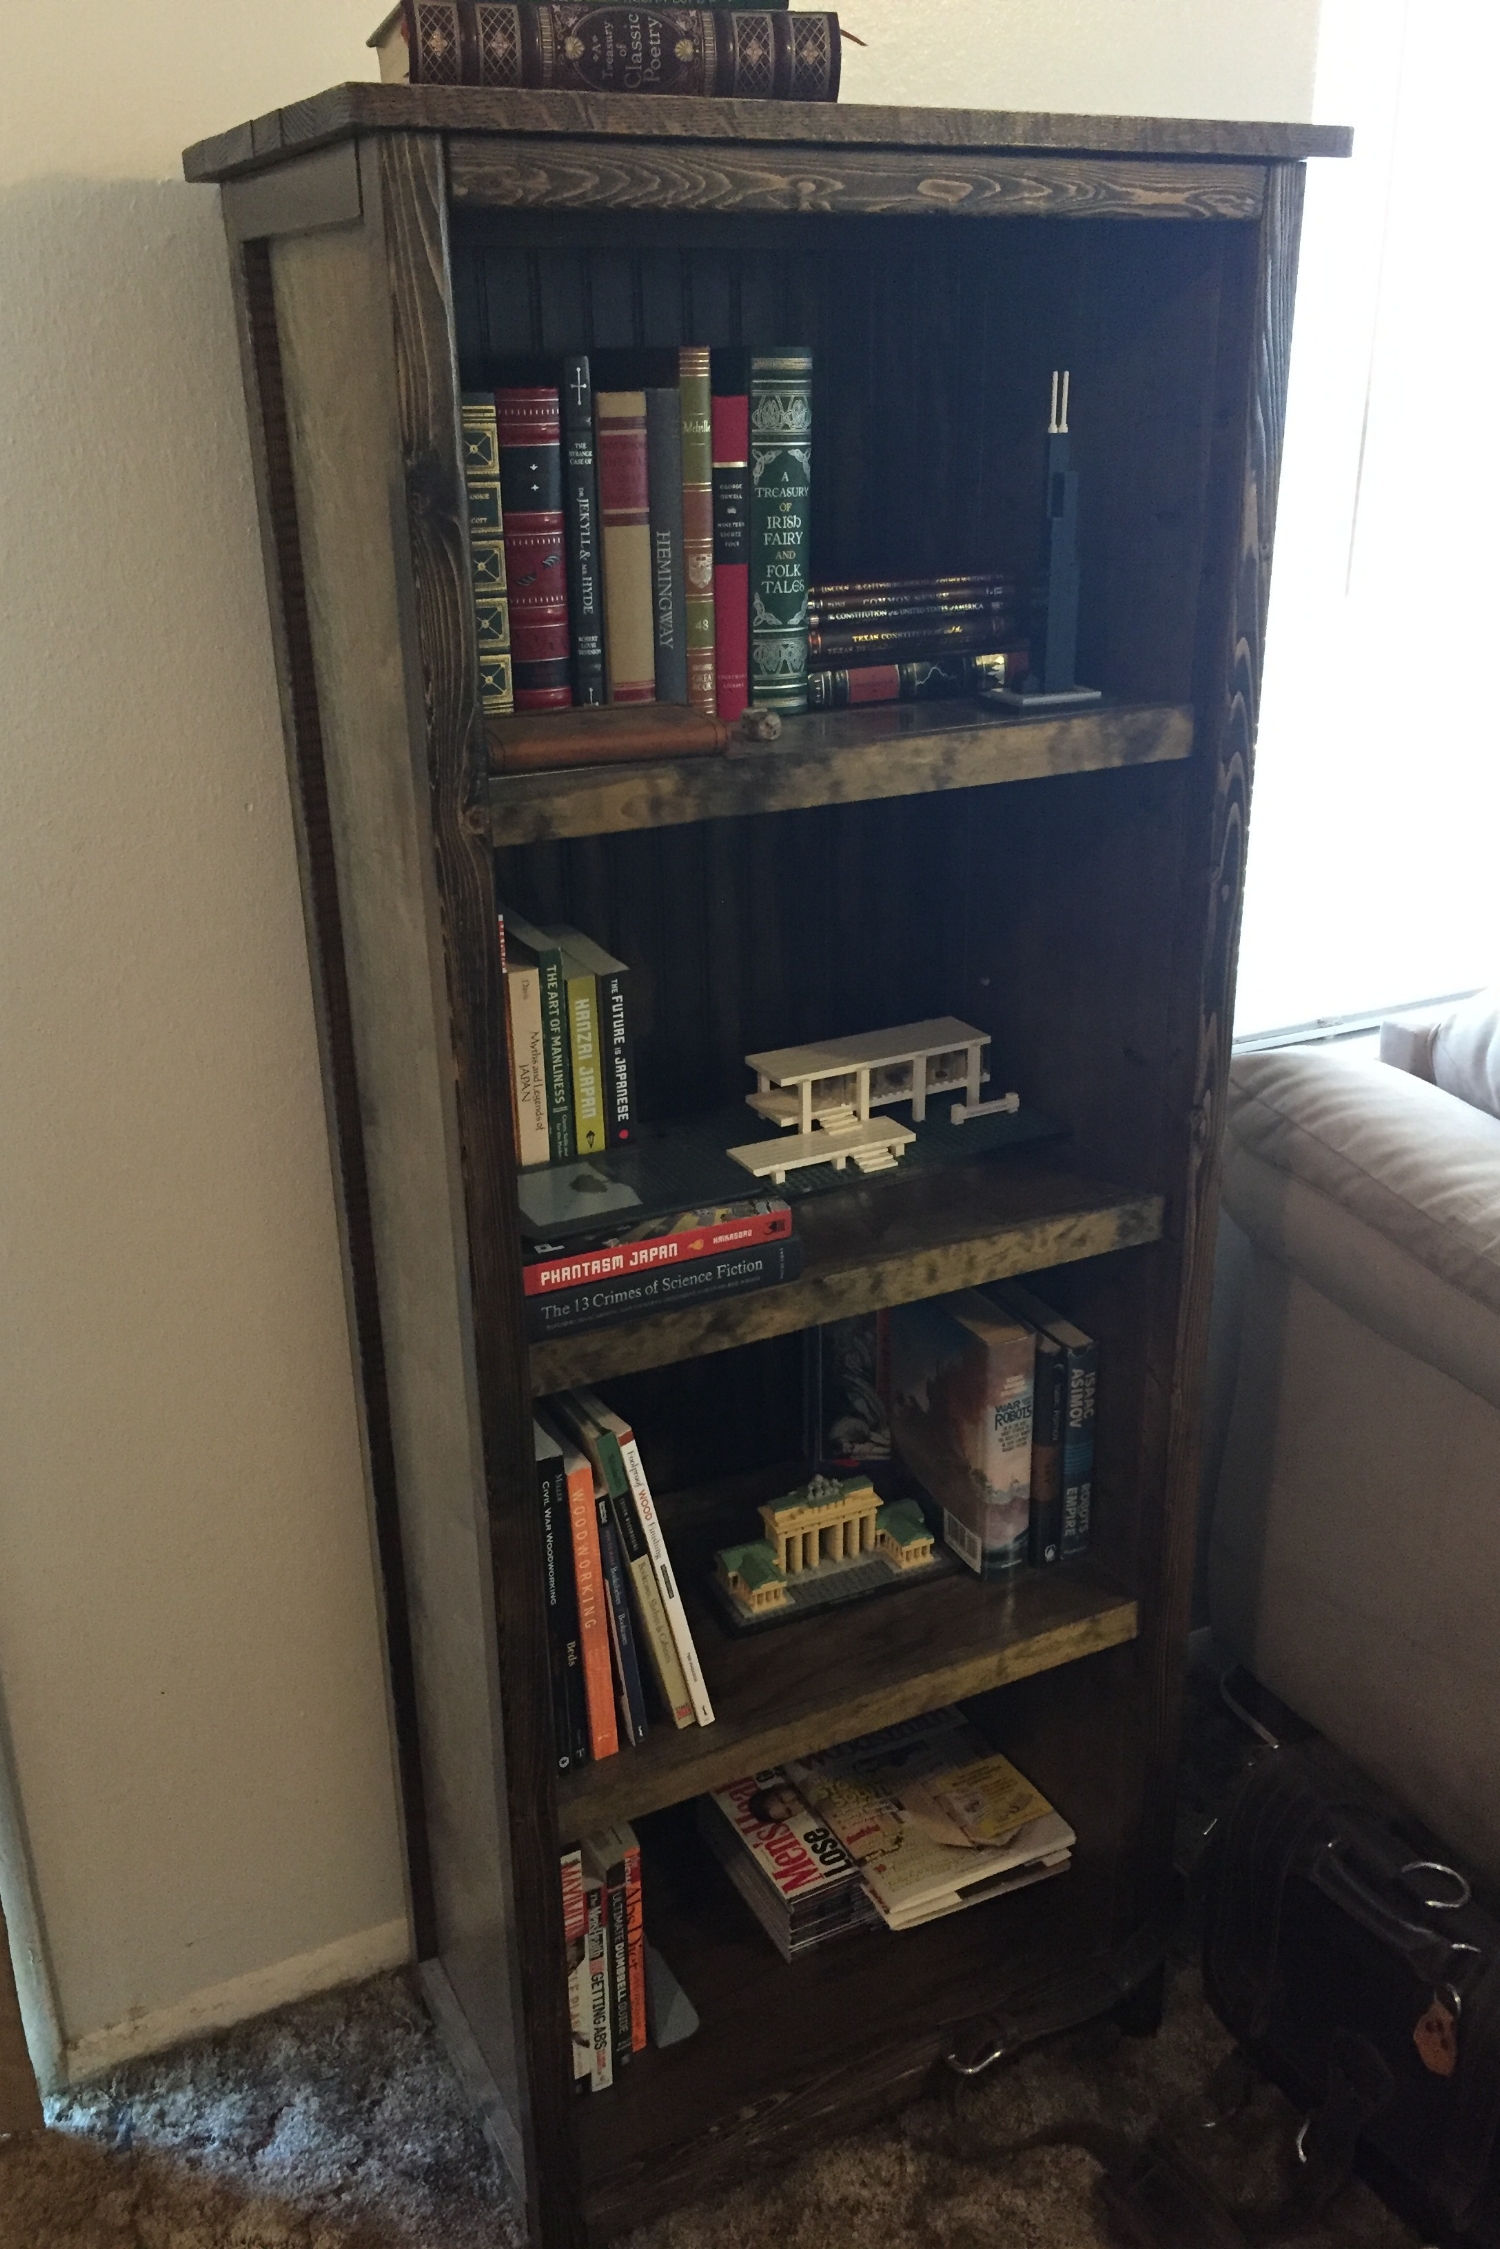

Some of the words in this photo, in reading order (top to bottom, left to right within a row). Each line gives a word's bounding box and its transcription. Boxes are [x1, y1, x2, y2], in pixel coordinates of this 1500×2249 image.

[592, 43, 602, 54] A
[602, 21, 614, 79] Treasury
[616, 43, 627, 57] of
[624, 13, 643, 88] Classic
[643, 17, 663, 83] Poetry
[755, 486, 809, 499] TREASURY
[781, 471, 789, 482] A
[577, 499, 590, 549] JEKYLL
[779, 502, 792, 513] OF
[580, 550, 590, 561] &
[763, 531, 804, 547] FAIRY
[774, 549, 796, 561] AND
[761, 578, 806, 595] TALES
[765, 563, 802, 578] FOLK
[583, 577, 594, 615] HYDE
[656, 531, 675, 650] HEMINGWAY
[835, 610, 887, 620] CONSTITUTION
[955, 602, 985, 611] AMERICA
[852, 634, 879, 642] TEXAS
[546, 965, 558, 989] THE
[548, 991, 560, 1018] ART
[612, 995, 626, 1044] FUTURE
[550, 1020, 561, 1033] OF
[575, 998, 592, 1061] HANZAI
[530, 1031, 541, 1064] Myths
[614, 1047, 621, 1055] IS
[519, 1064, 531, 1102] JAPAN
[532, 1065, 542, 1081] and
[551, 1035, 565, 1104] MANLINESS
[533, 1083, 545, 1120] Legends
[579, 1065, 597, 1119] JAPAN
[615, 1056, 630, 1122] JAPANESE
[535, 1121, 545, 1131] of
[540, 1255, 624, 1286] PHANTASM
[629, 1243, 679, 1266] JAPAN
[713, 1229, 753, 1245] HAIKASORU
[541, 1303, 570, 1320] The
[574, 1297, 590, 1313] 13
[592, 1286, 642, 1308] Crimes
[645, 1279, 659, 1296] of
[662, 1271, 714, 1293] Science
[716, 1258, 764, 1281] Fiction
[995, 1400, 1021, 1413] WAR
[1069, 1369, 1084, 1428] ASIMOV
[1083, 1371, 1096, 1419] ISAAC
[995, 1405, 1032, 1431] ROBOTS
[542, 1480, 550, 1507] CIVIL
[626, 1450, 643, 1488] Foolproof
[637, 1488, 654, 1521] WOOD
[648, 1521, 663, 1560] Finishing
[1064, 1486, 1078, 1536] EMPIRE
[1079, 1482, 1091, 1534] ROBOTS
[544, 1507, 552, 1532] WAR
[546, 1532, 557, 1606] WOODWORKING
[572, 1488, 597, 1629] WOODWORKING
[566, 1640, 577, 1667] Beds
[752, 1823, 824, 1894] Men's
[803, 1828, 854, 1878] Lose
[611, 1893, 623, 1941] ULTIMATE
[626, 1887, 642, 1924] Abs
[614, 1942, 628, 2001] DUMBBELL
[591, 1972, 606, 2022] GETTING
[617, 2001, 629, 2034] GUIDE
[593, 2024, 607, 2051] ABS
